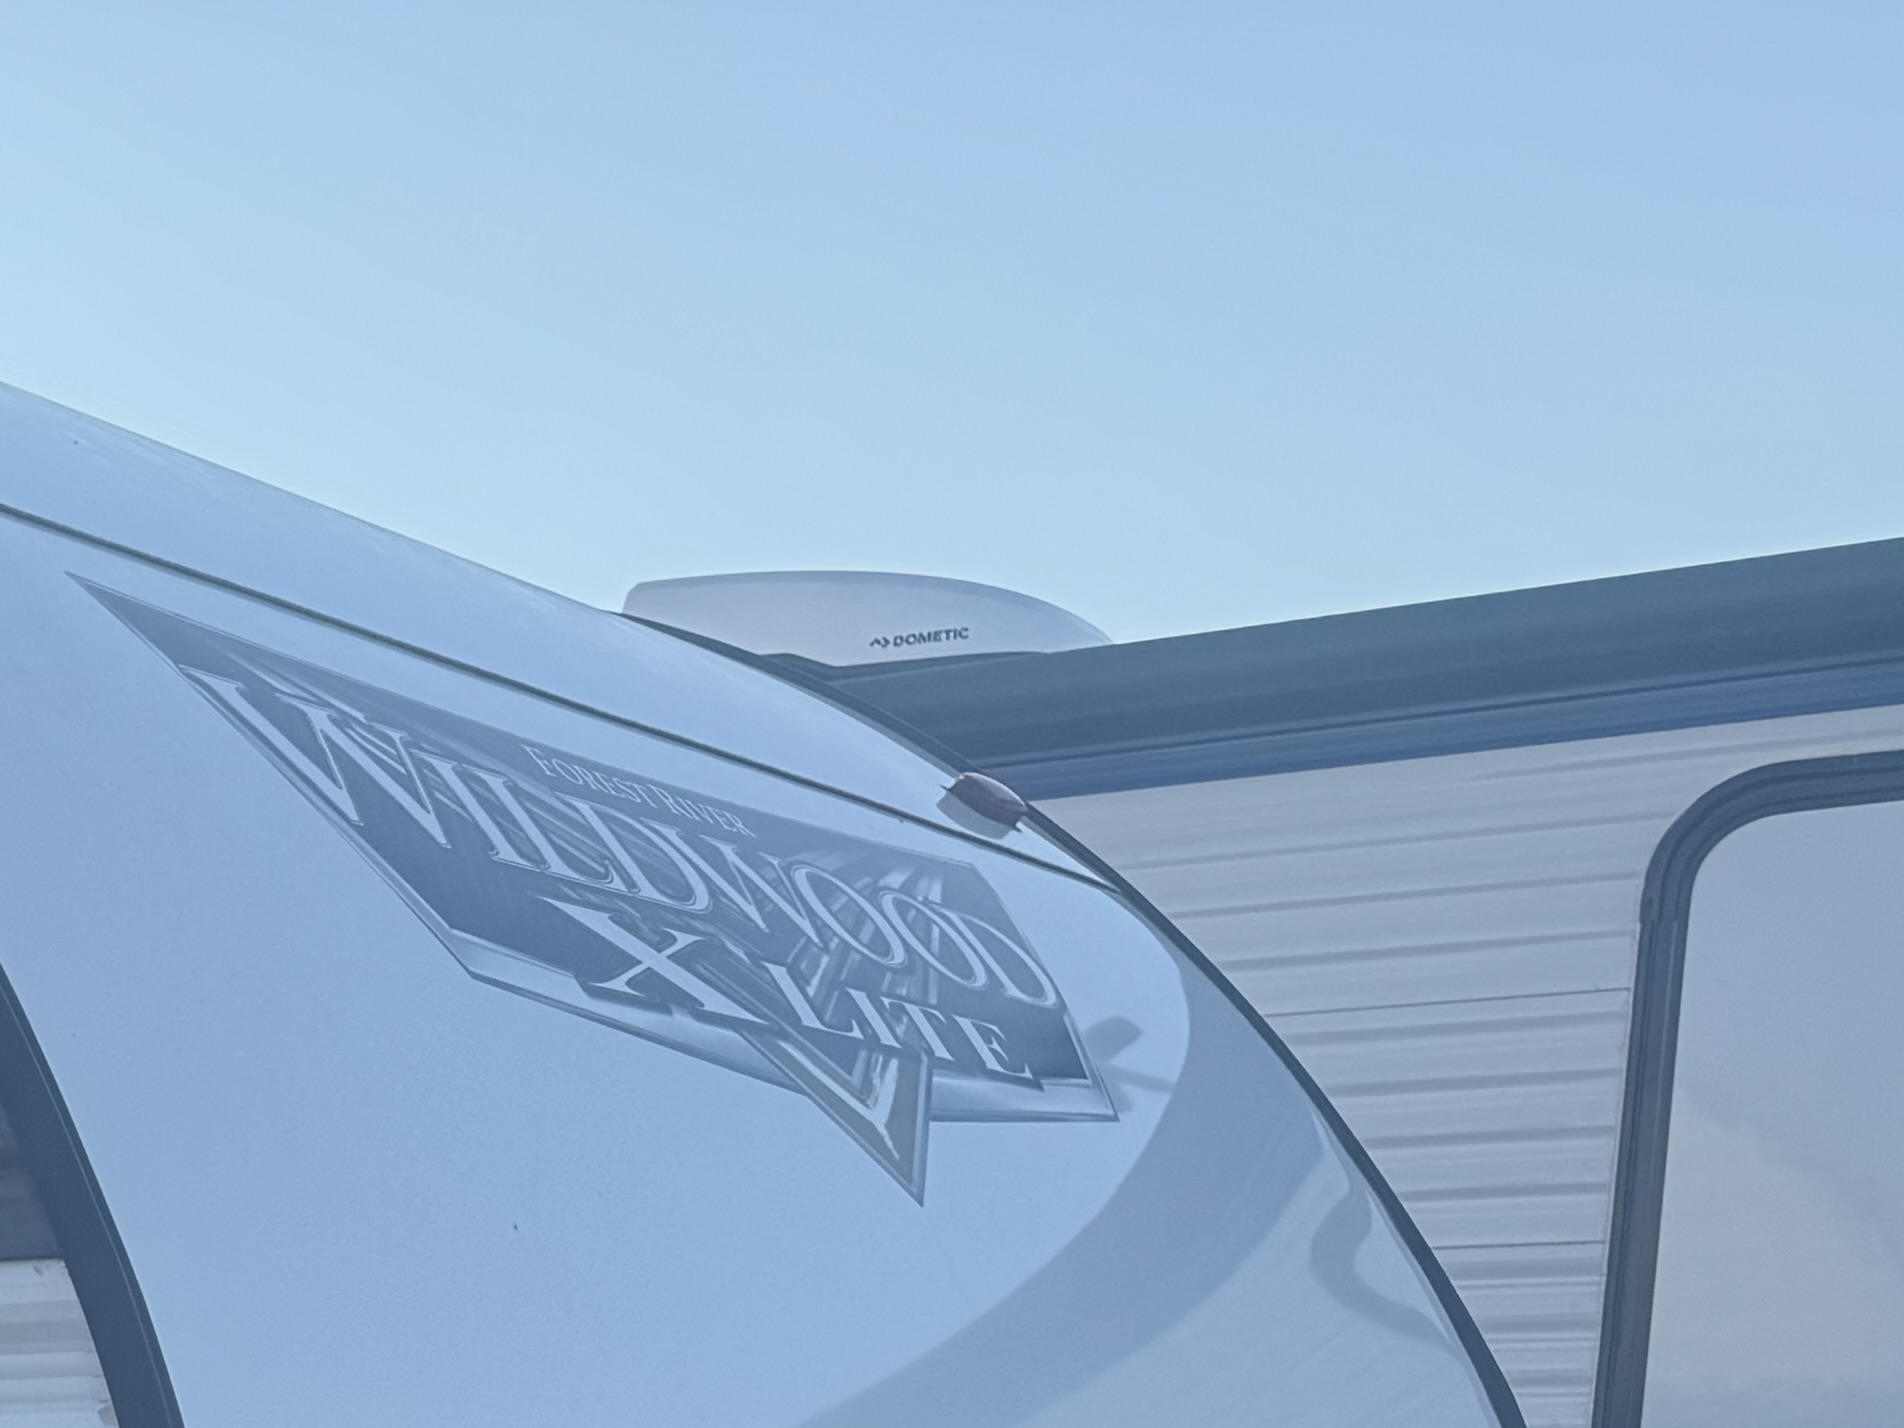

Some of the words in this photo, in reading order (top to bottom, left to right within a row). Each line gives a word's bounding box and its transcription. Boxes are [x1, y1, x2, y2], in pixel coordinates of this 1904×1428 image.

[893, 627, 969, 648] DOMETIC
[180, 664, 1061, 1010] WILDWOOD
[520, 744, 658, 808] FOREST
[648, 784, 757, 838] RIVER
[540, 894, 770, 1025] X
[761, 959, 1037, 1081] LITE
